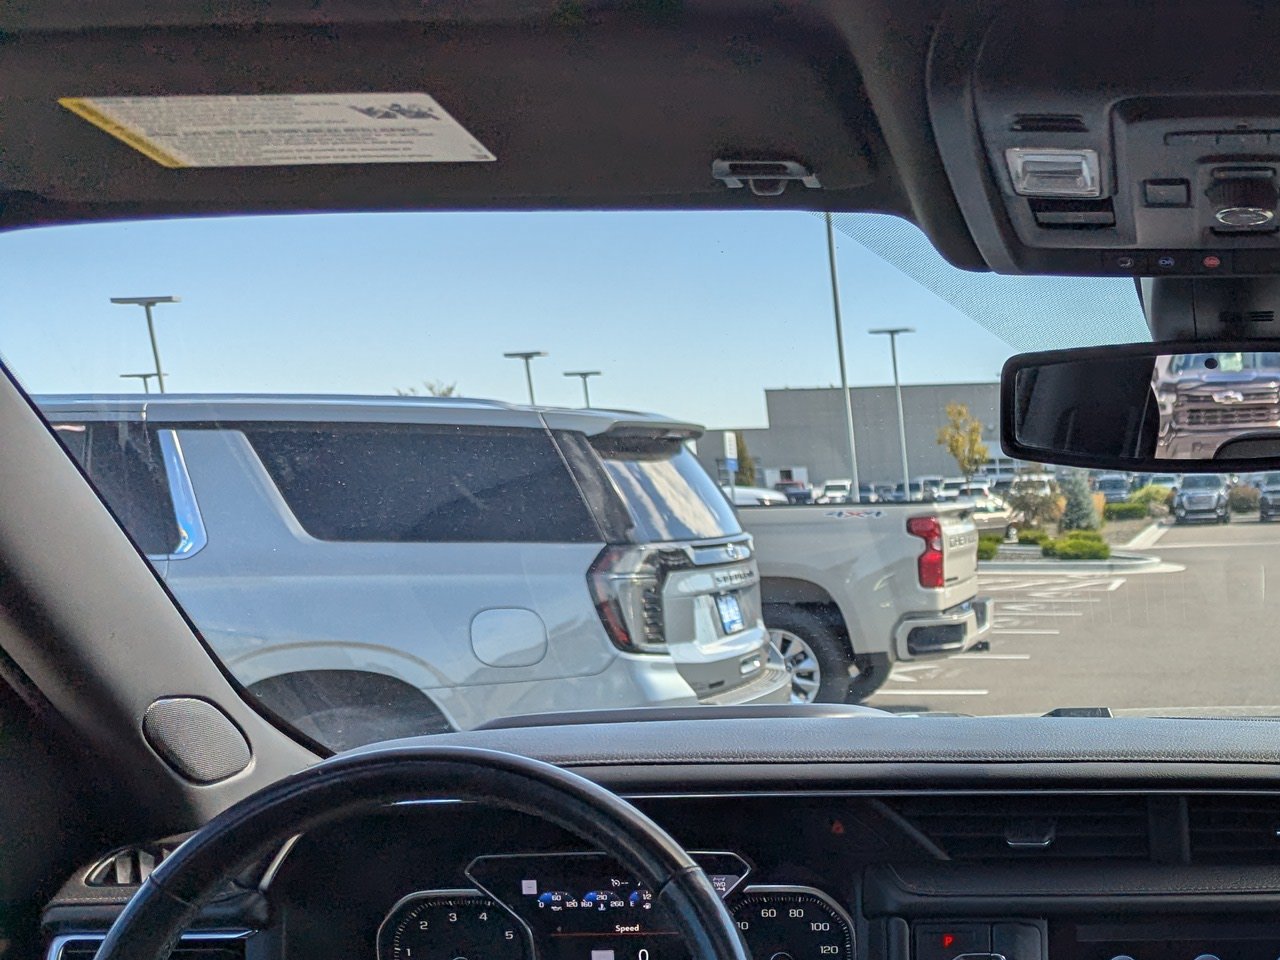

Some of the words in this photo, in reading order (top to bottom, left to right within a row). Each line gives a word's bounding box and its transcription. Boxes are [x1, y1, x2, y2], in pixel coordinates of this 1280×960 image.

[448, 913, 458, 922] 3
[478, 912, 488, 921] 4
[761, 908, 777, 918] 60
[788, 908, 804, 918] 80
[419, 920, 429, 930] 2
[615, 924, 640, 933] Speed
[810, 922, 830, 931] 100
[504, 930, 514, 940] 5
[944, 935, 953, 947] P
[406, 948, 411, 957] 1
[820, 945, 839, 954] 120
